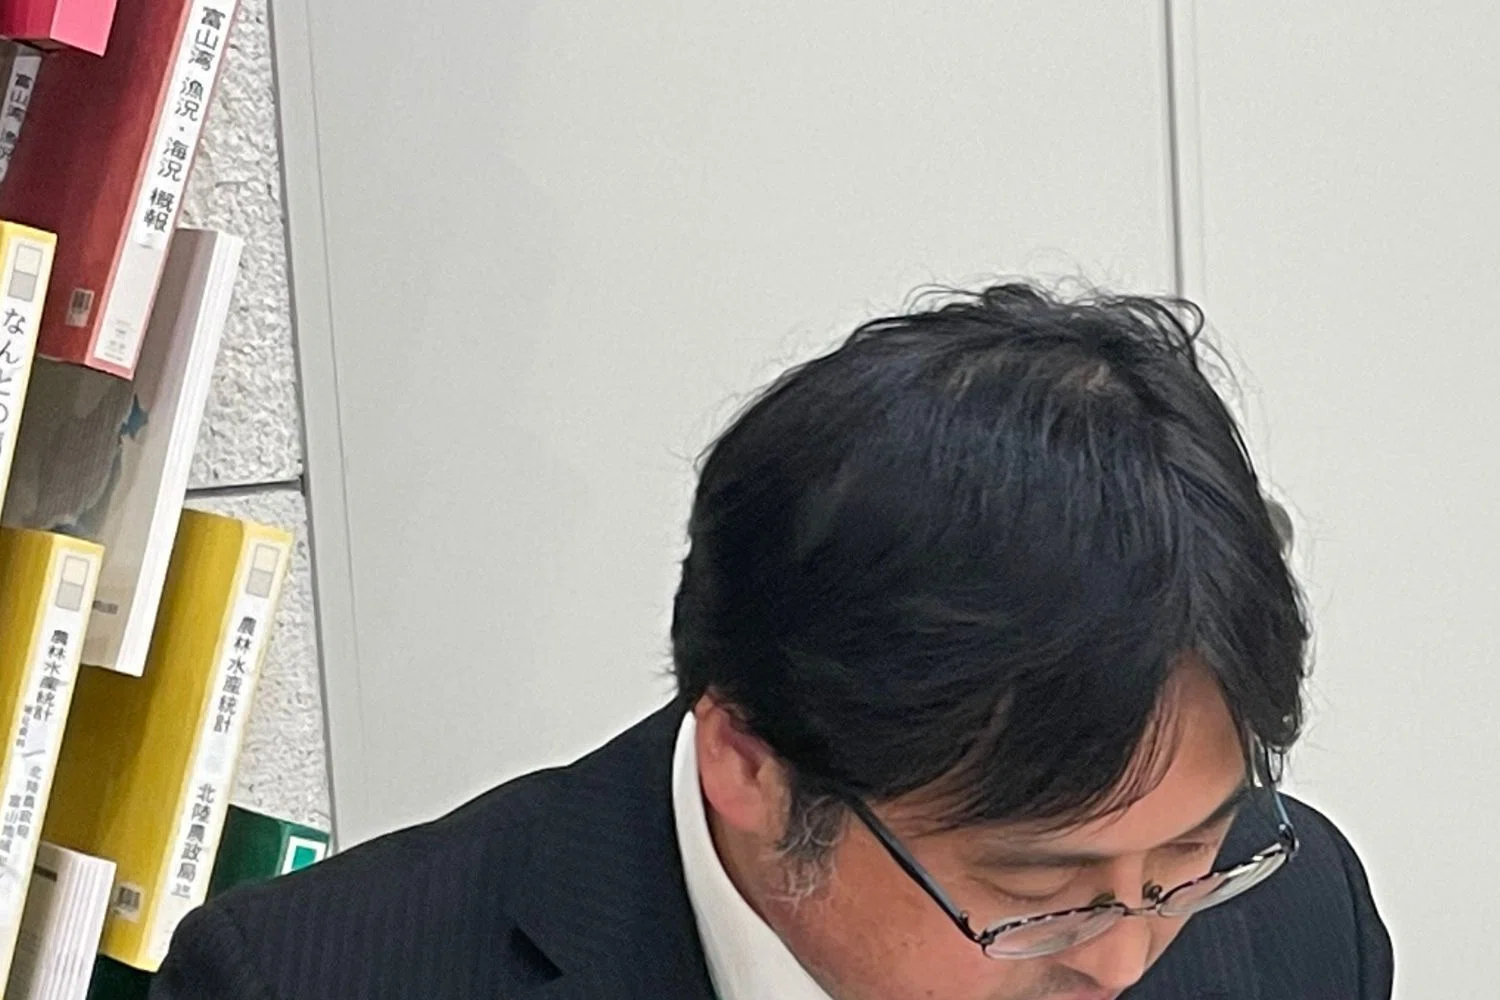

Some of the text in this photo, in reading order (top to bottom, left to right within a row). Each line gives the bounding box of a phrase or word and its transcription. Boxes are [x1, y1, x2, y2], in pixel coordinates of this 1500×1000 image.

[188, 7, 226, 71] 富山湾
[143, 187, 175, 232] 概報
[33, 629, 69, 722] 農林水産統計
[213, 616, 257, 733] 農林水産統計
[176, 783, 216, 883] 北陸農政局
